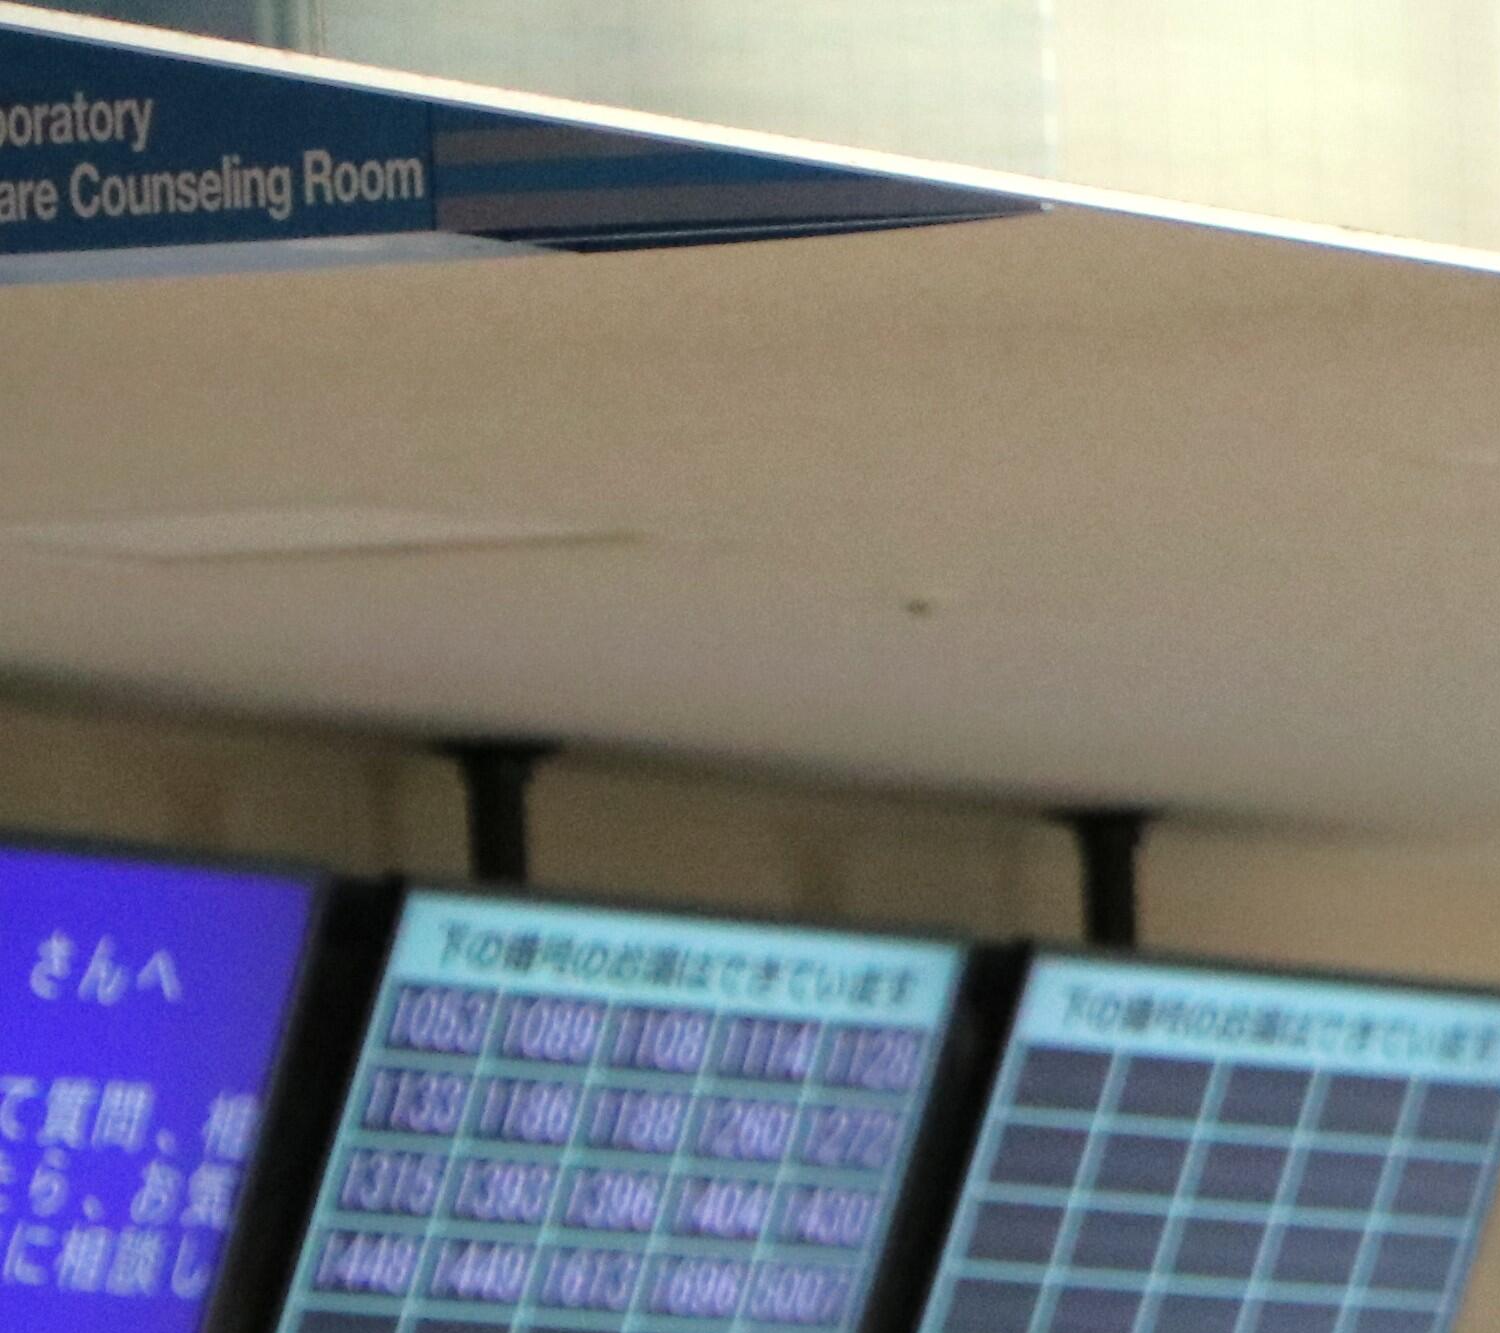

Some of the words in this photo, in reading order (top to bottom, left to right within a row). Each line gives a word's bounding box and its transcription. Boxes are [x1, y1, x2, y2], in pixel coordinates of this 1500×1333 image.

[0, 91, 152, 152] oratory
[70, 154, 293, 221] Counseling
[303, 149, 425, 205] Room
[29, 928, 184, 1007] さんへ
[612, 1008, 706, 1074] 1108
[720, 1019, 815, 1081] 1114
